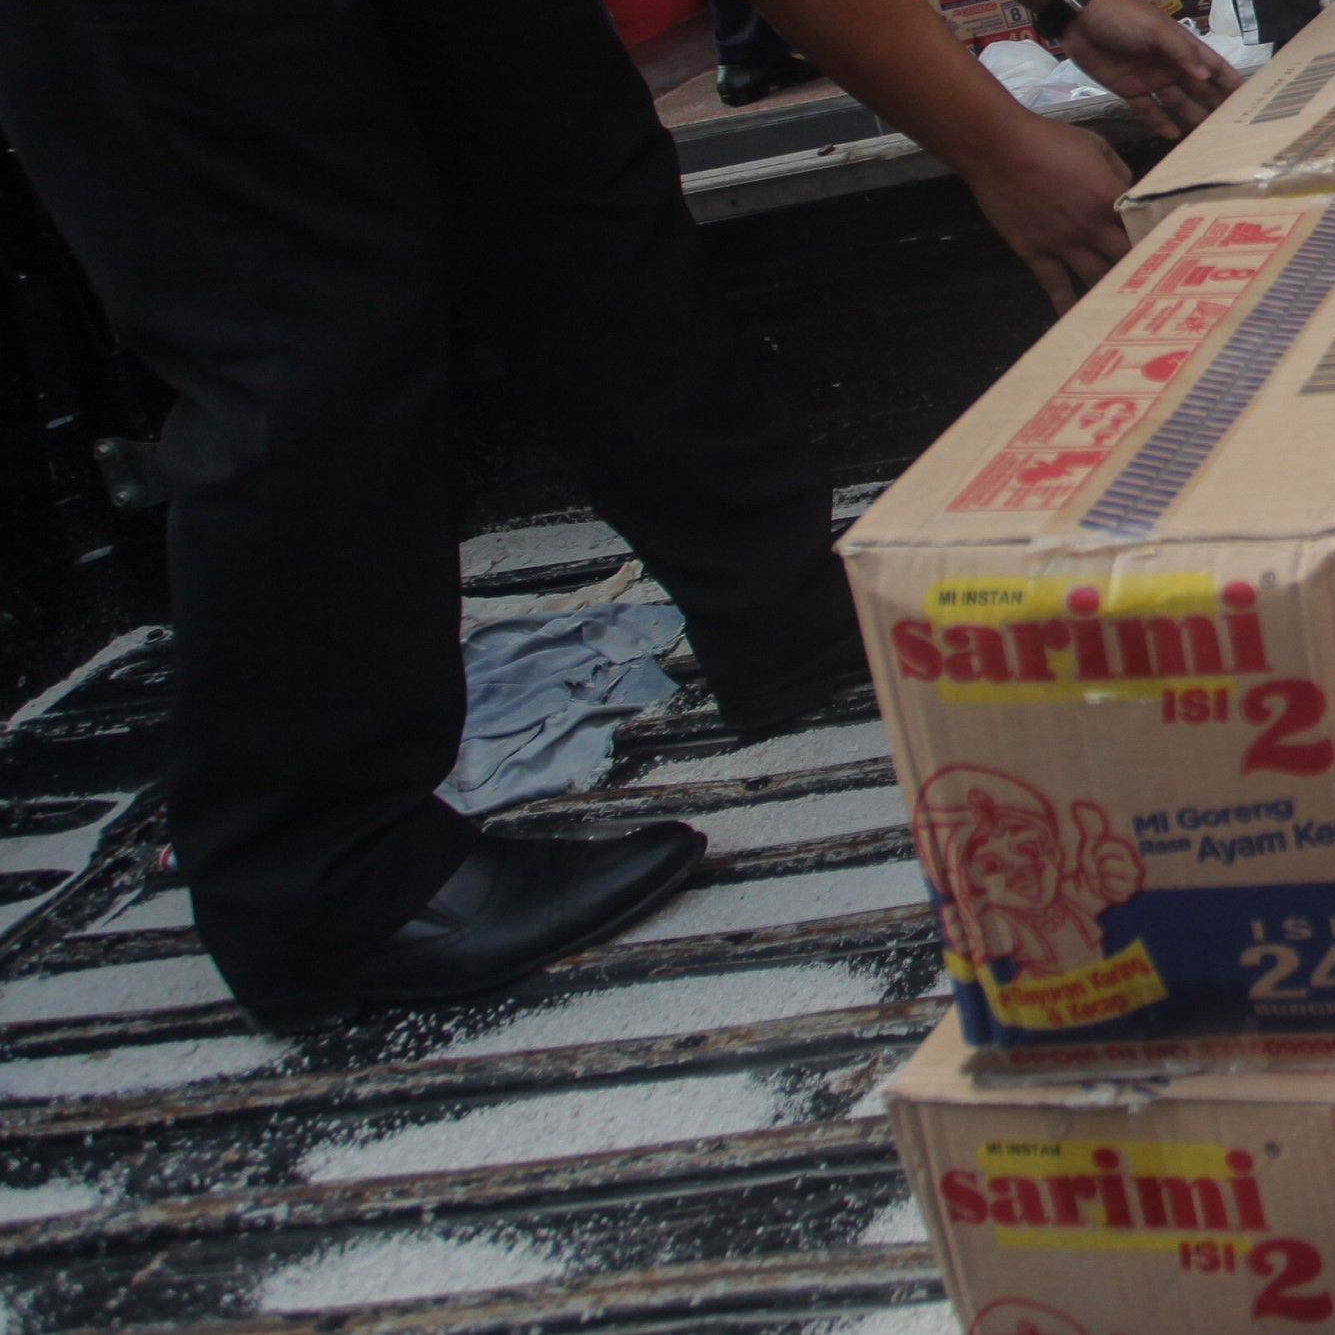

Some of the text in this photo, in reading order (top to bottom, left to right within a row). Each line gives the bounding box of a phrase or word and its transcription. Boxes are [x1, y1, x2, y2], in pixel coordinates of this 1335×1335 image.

[938, 589, 1024, 607] MI INSTAN
[889, 581, 1274, 685] sarimi
[1160, 688, 1230, 726] ISI
[1133, 797, 1295, 837] Mi Goreng
[1197, 829, 1287, 866] Ayam
[939, 1147, 1271, 1233] sarimi
[1178, 1238, 1335, 1325] ISI 2
